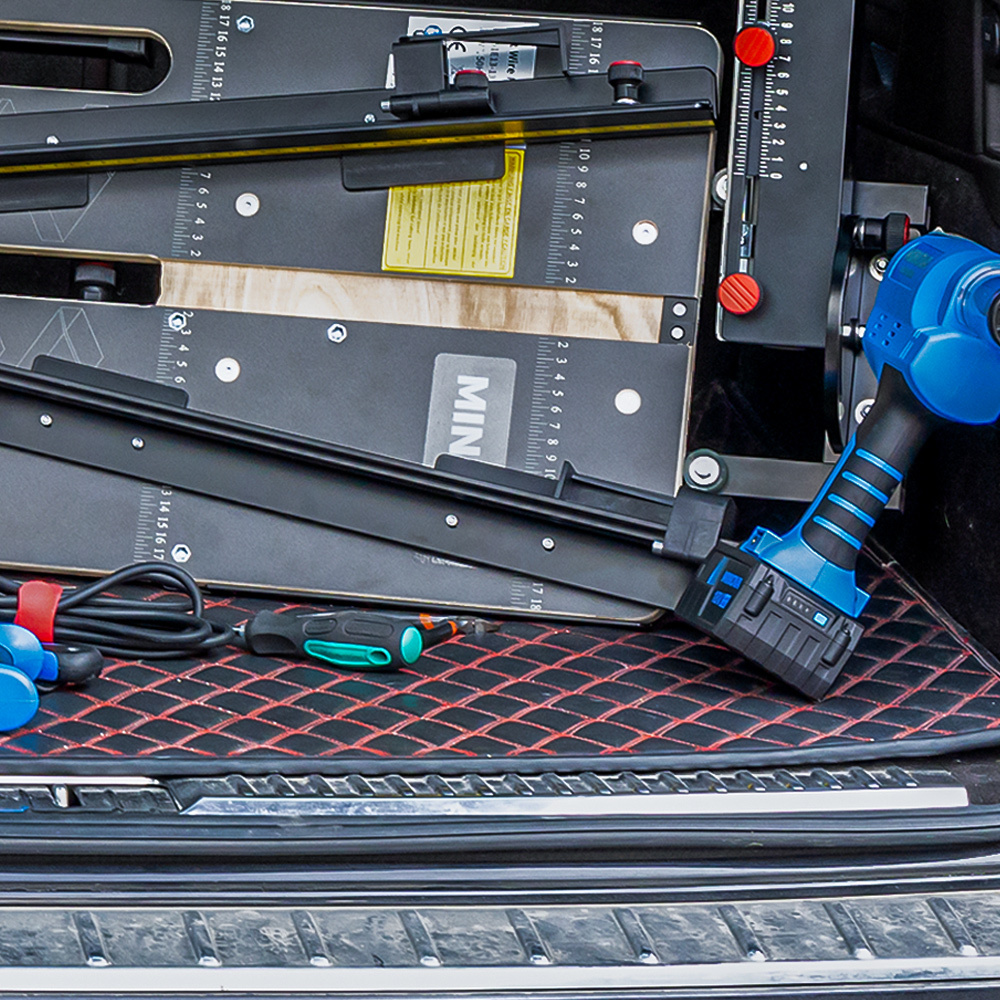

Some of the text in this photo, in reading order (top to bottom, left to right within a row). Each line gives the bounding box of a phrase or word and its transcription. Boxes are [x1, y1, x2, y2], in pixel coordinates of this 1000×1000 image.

[782, 3, 794, 13] 10
[220, 15, 230, 26] 17
[217, 31, 228, 41] 16
[591, 37, 602, 49] 17
[216, 46, 226, 57] 15
[507, 51, 518, 74] Wire
[589, 53, 600, 65] 16
[214, 62, 225, 72] 14
[212, 77, 222, 88] 13
[578, 148, 591, 160] 10
[572, 213, 584, 221] 6
[569, 244, 580, 252] 4
[554, 373, 566, 381] 4
[552, 390, 564, 398] 5
[546, 454, 557, 462] 9
[160, 501, 171, 512] 14
[157, 517, 168, 528] 15
[155, 533, 167, 544] 16
[153, 548, 165, 560] 17
[530, 582, 543, 610] 17 18
